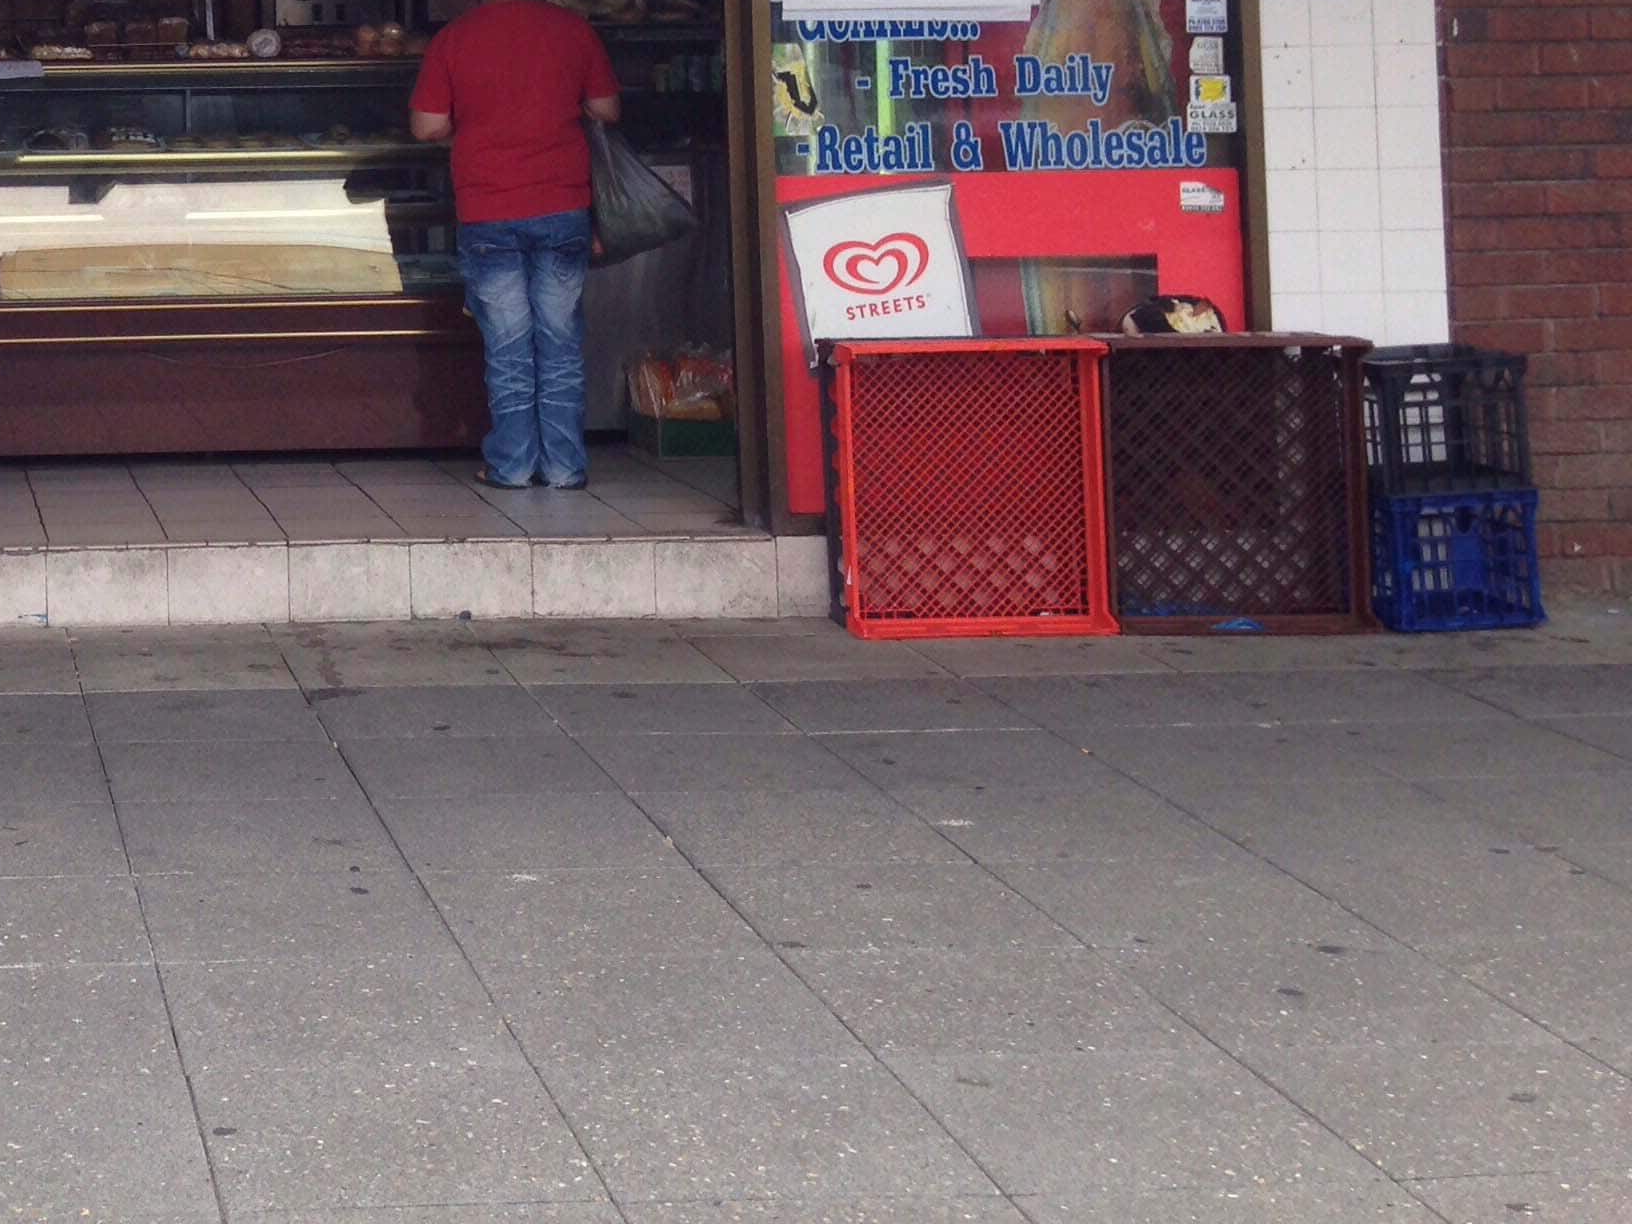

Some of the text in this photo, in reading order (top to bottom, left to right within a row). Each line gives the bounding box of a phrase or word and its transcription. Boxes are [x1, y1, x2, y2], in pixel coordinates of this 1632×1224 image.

[888, 55, 998, 99] Fresh
[1016, 53, 1113, 106] Daily
[1190, 110, 1234, 120] GLASS
[816, 122, 935, 174] Retail
[951, 120, 984, 172] &
[1000, 115, 1206, 171] Wholesale
[846, 295, 926, 321] STREETS
